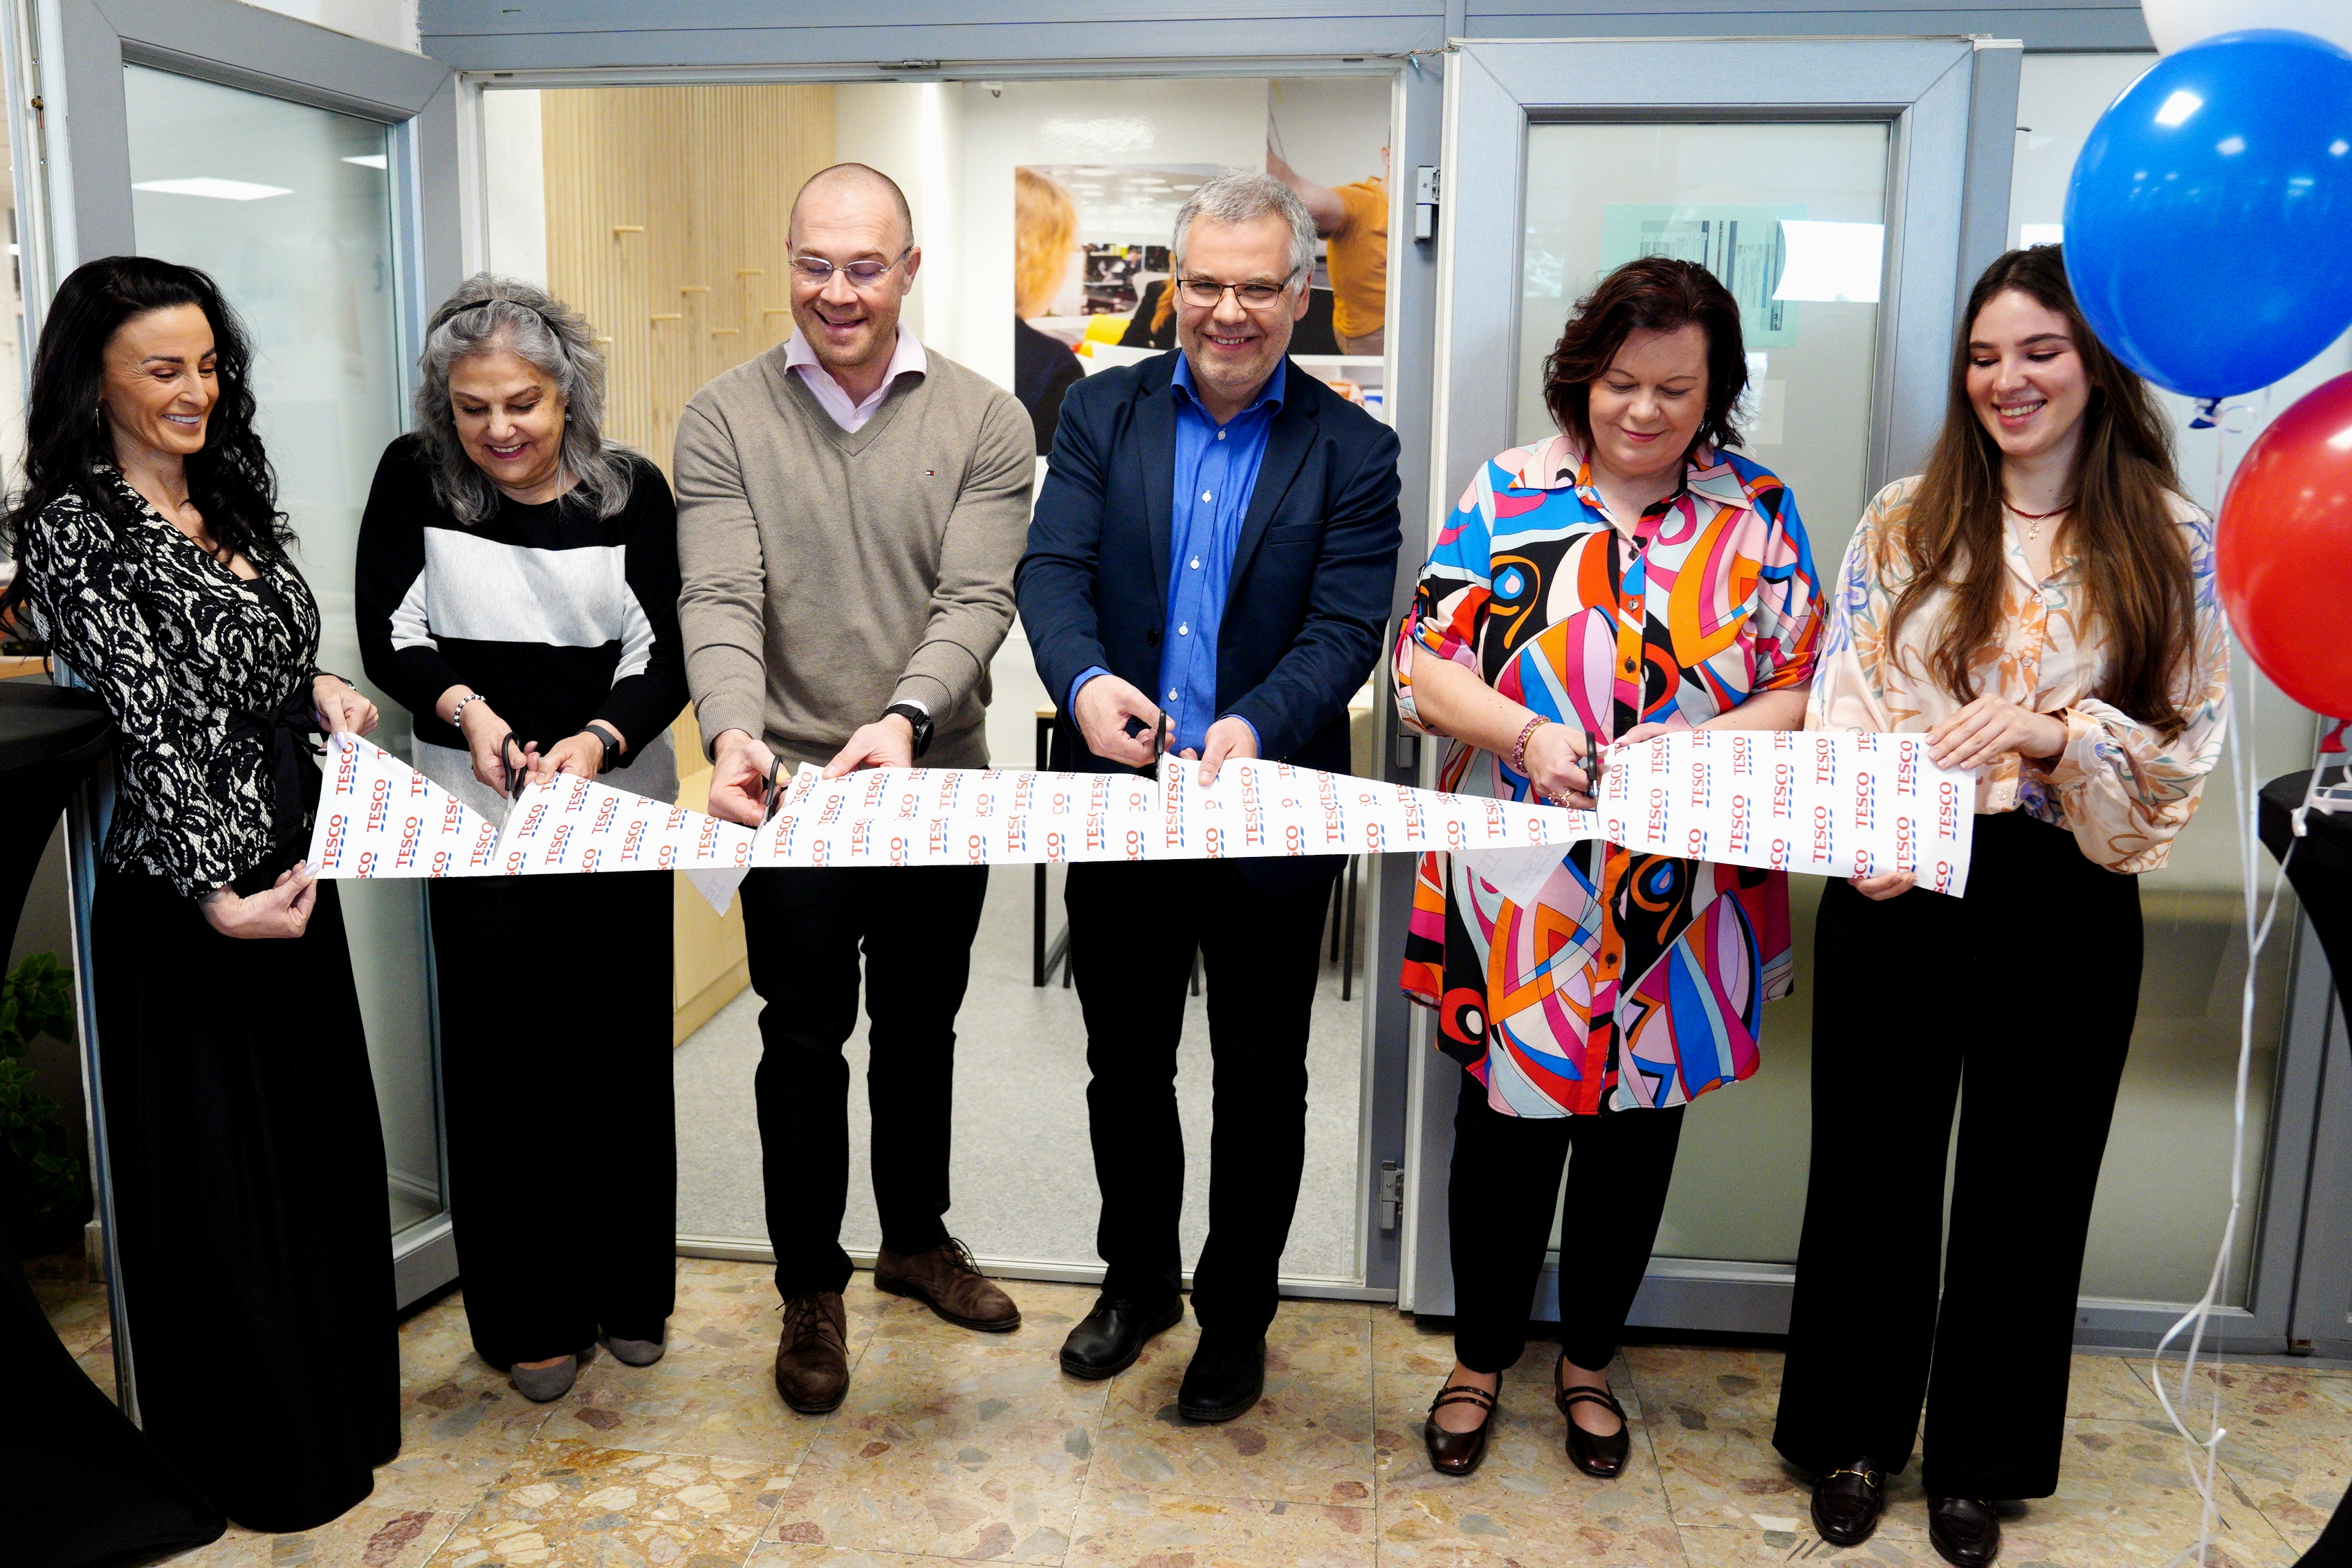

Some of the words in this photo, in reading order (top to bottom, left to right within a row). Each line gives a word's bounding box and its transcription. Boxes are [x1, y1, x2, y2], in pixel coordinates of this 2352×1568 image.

[1652, 738, 1664, 774] TESCO
[1734, 737, 1746, 775] TESCO
[1816, 739, 1829, 784] TESCO
[1898, 741, 1913, 795] TESCO
[565, 779, 588, 812] TESCO
[864, 773, 884, 807] TESCO
[939, 773, 957, 809] TESCO
[1015, 774, 1031, 810] TESCO
[1092, 776, 1107, 810] TESCO
[1167, 763, 1179, 810] TESCO
[1610, 764, 1623, 800] TESCO
[1691, 763, 1705, 807] TESCO
[1773, 764, 1788, 818] TESCO
[1856, 772, 1869, 829] TESCO
[367, 779, 386, 832] TESCO
[518, 804, 542, 838] TESCO
[591, 797, 614, 834] TESCO
[818, 795, 839, 825] TESCO
[1482, 800, 1500, 838] TESCO
[1648, 788, 1662, 842] TESCO
[1729, 795, 1745, 853] TESCO
[1940, 782, 1951, 838] TESCO
[322, 815, 342, 869] TESCO
[396, 816, 417, 867] TESCO
[470, 822, 493, 867] TESCO
[545, 825, 568, 865] TESCO
[621, 821, 642, 862] TESCO
[697, 818, 717, 860] TESCO
[774, 815, 793, 857] TESCO
[1812, 806, 1826, 863] TESCO
[1897, 817, 1910, 872] TESCO
